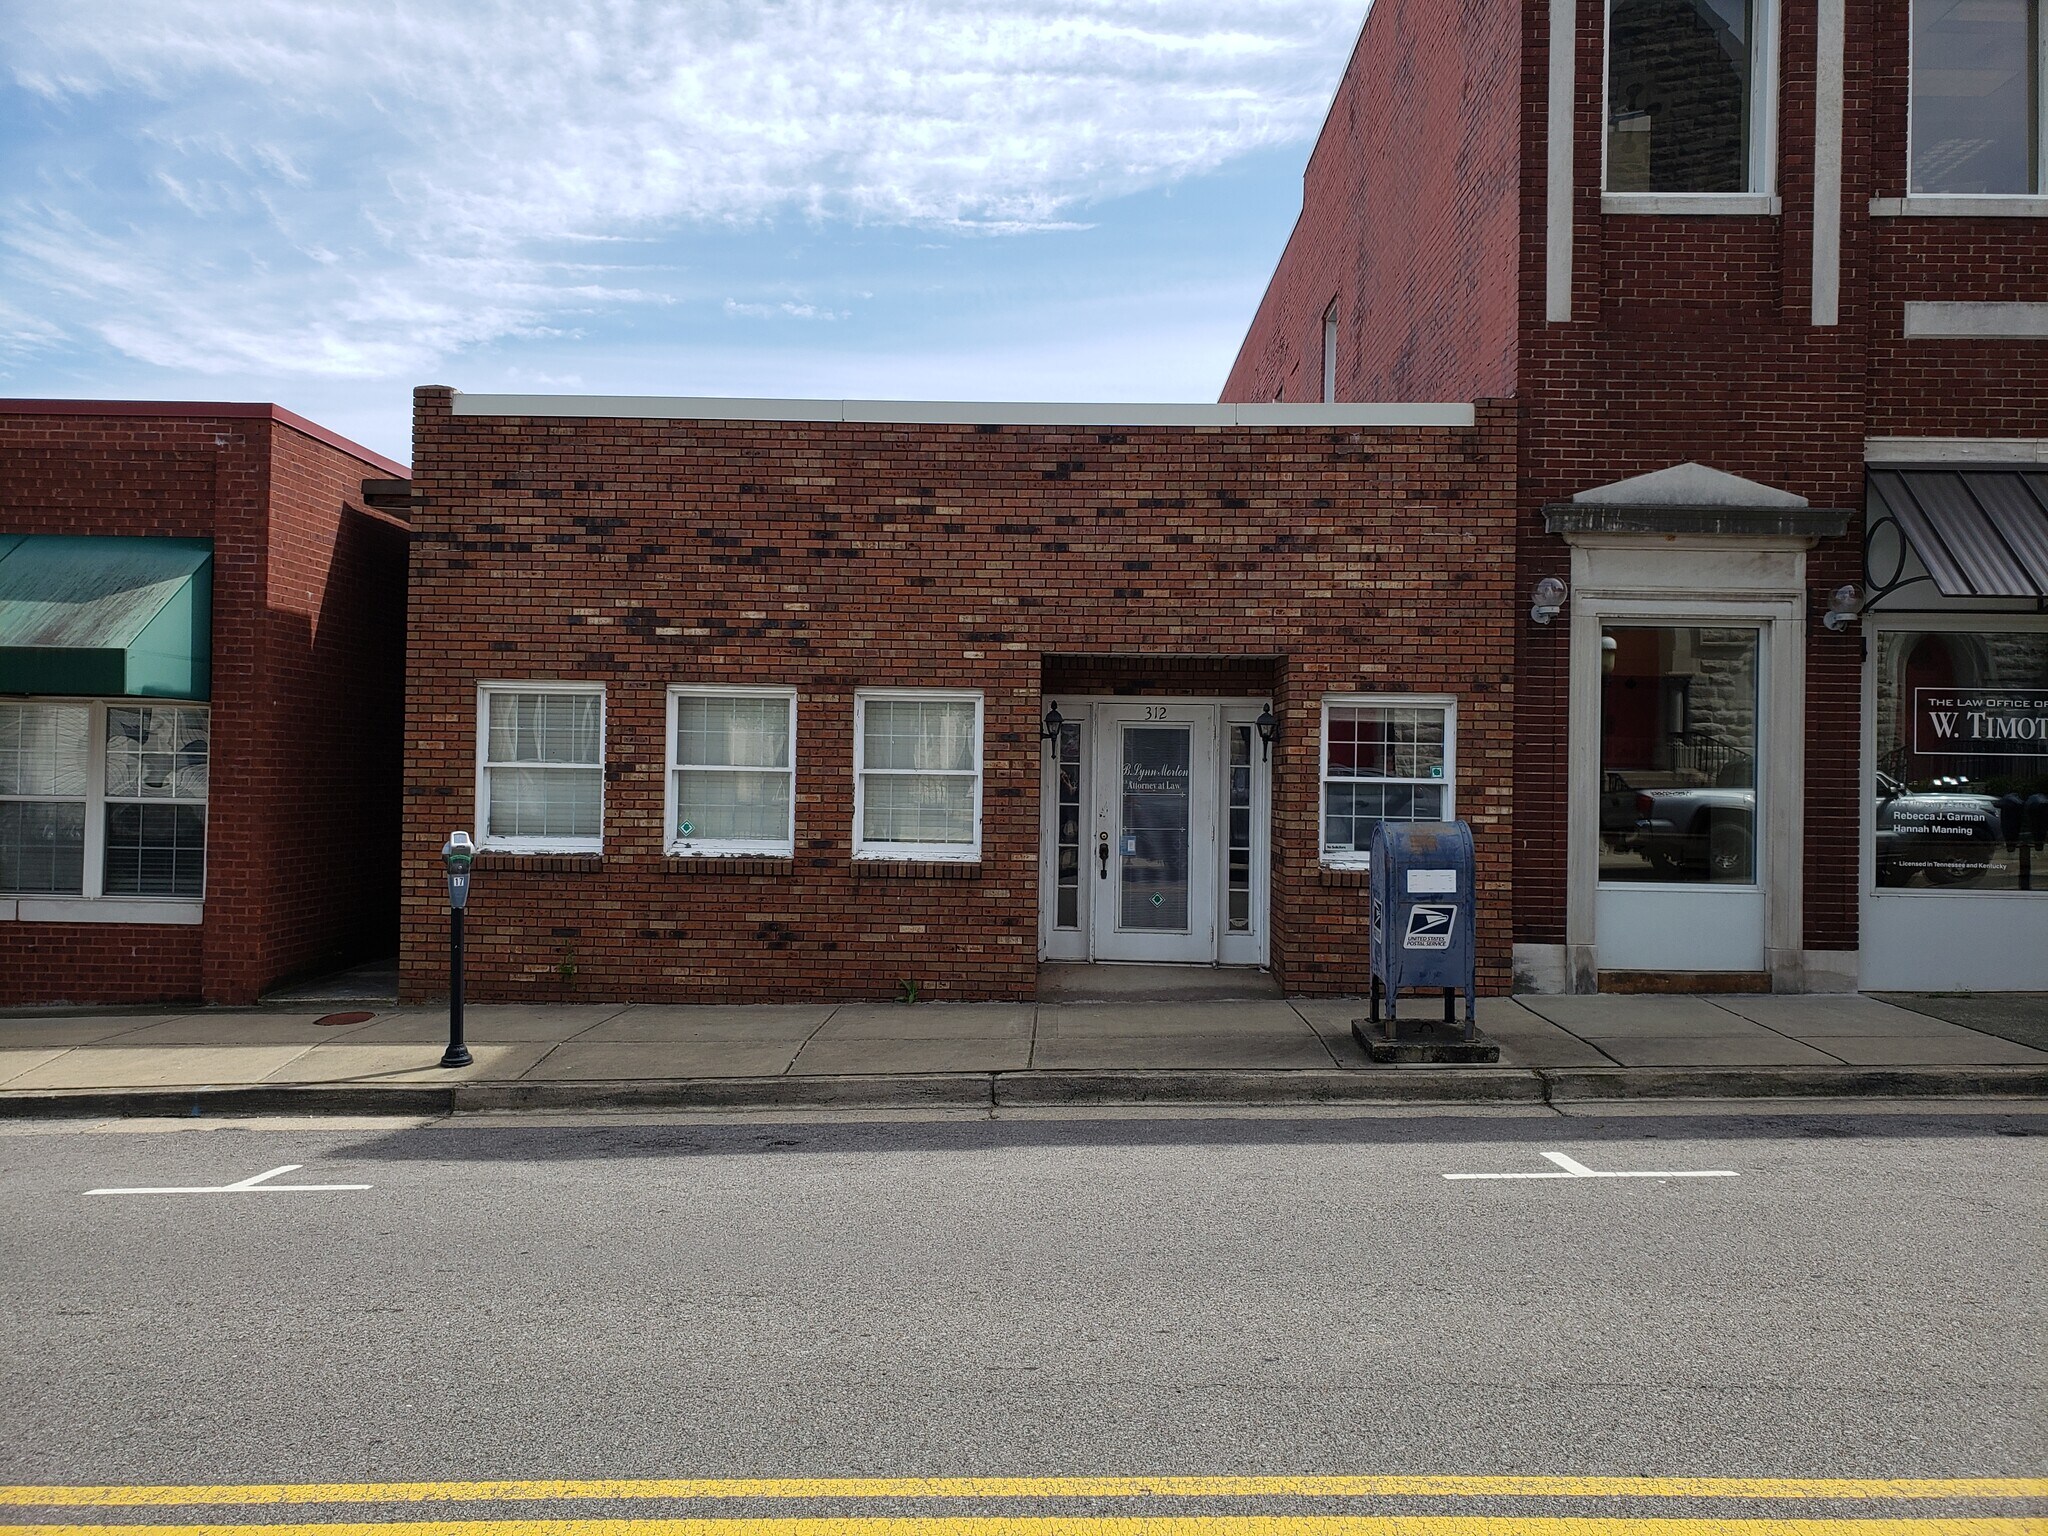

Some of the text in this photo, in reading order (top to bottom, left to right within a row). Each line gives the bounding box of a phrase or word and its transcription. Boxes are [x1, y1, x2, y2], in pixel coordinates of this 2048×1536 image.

[1928, 698, 1954, 707] THE
[1957, 698, 1983, 707] LAW
[1986, 699, 2031, 708] OFFICE
[1145, 706, 1167, 720] 312
[1928, 711, 2048, 740] W. TIMOT
[1133, 763, 1157, 781] Lynn
[1157, 764, 1189, 777] Morton
[1127, 780, 1180, 792] Attorney at Law
[1893, 811, 1986, 822] Rebecca J. Garman
[1893, 824, 1973, 836] Hannah Manning
[1978, 863, 2007, 871] Kentucky
[454, 877, 464, 886] 17
